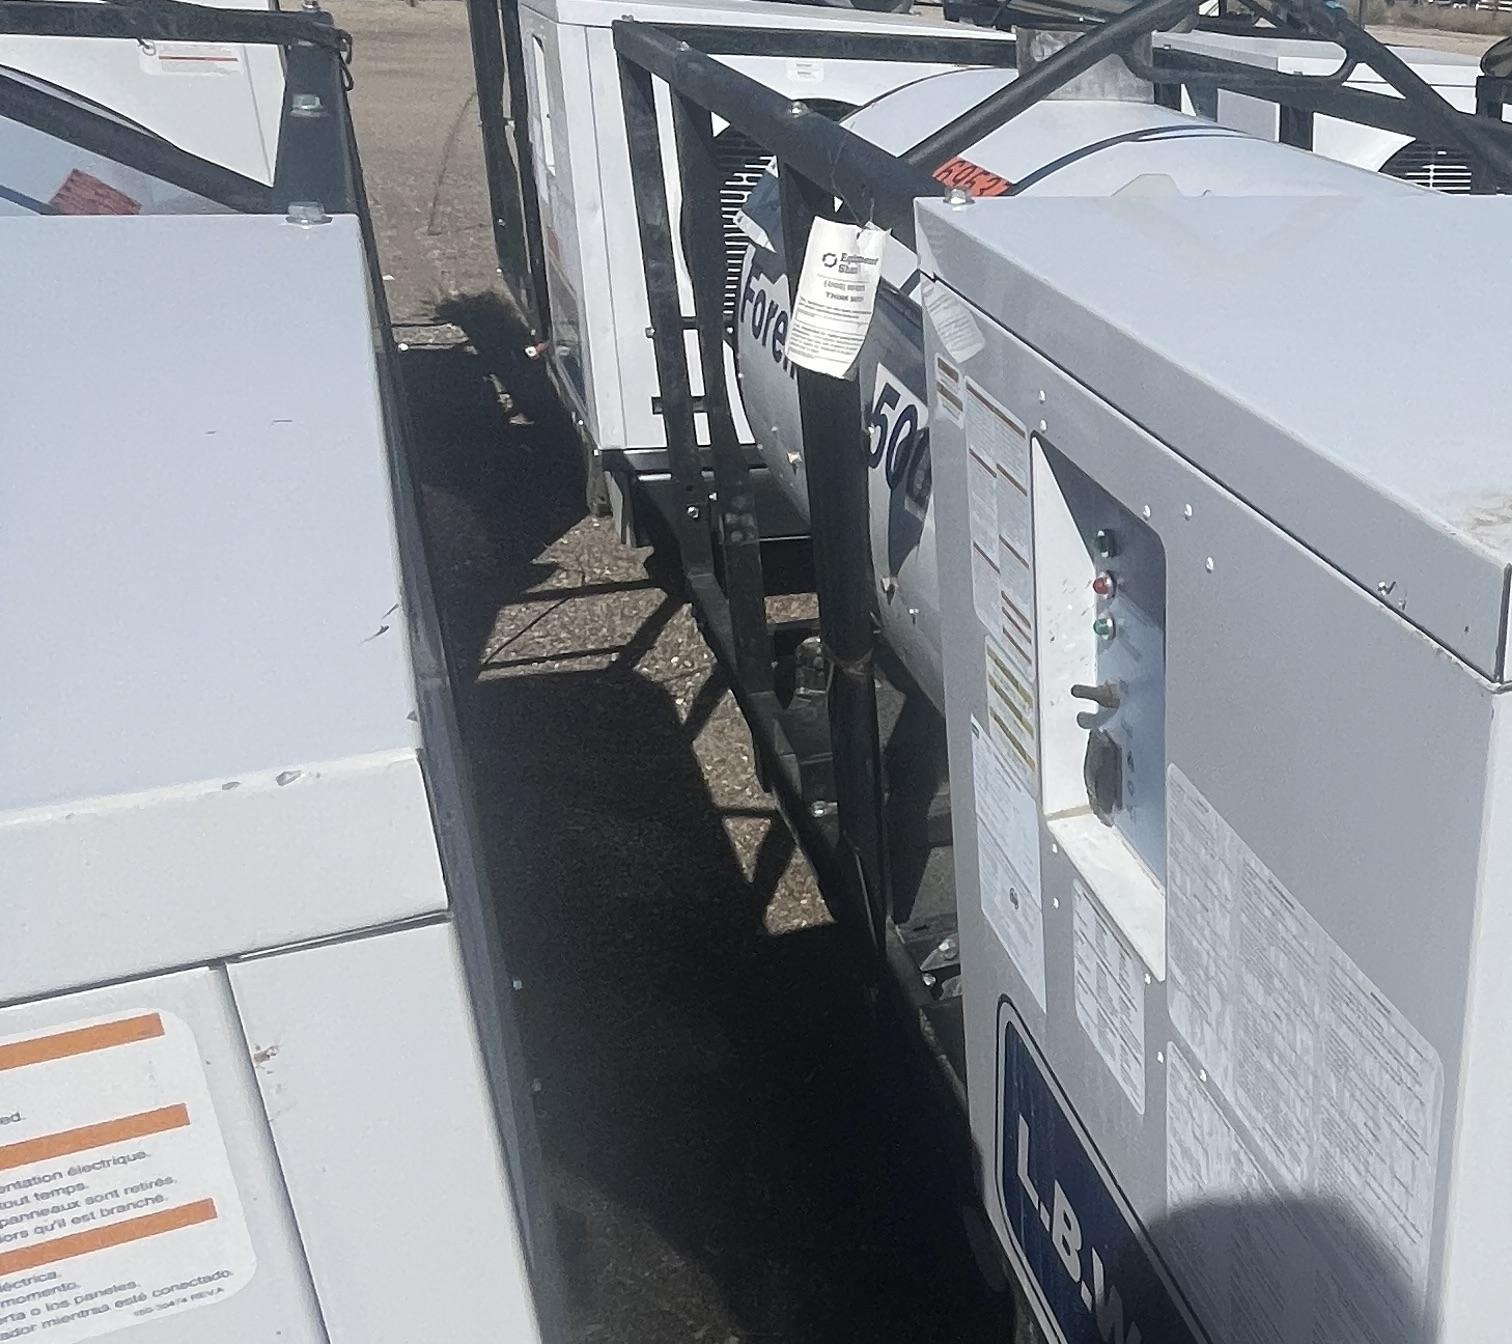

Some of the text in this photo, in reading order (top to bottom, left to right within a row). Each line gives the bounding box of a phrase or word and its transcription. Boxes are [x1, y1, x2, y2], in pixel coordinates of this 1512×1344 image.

[34, 1182, 89, 1202] temps.
[85, 1189, 120, 1205] sont
[71, 1210, 96, 1225] est
[152, 1268, 234, 1297] conectado.
